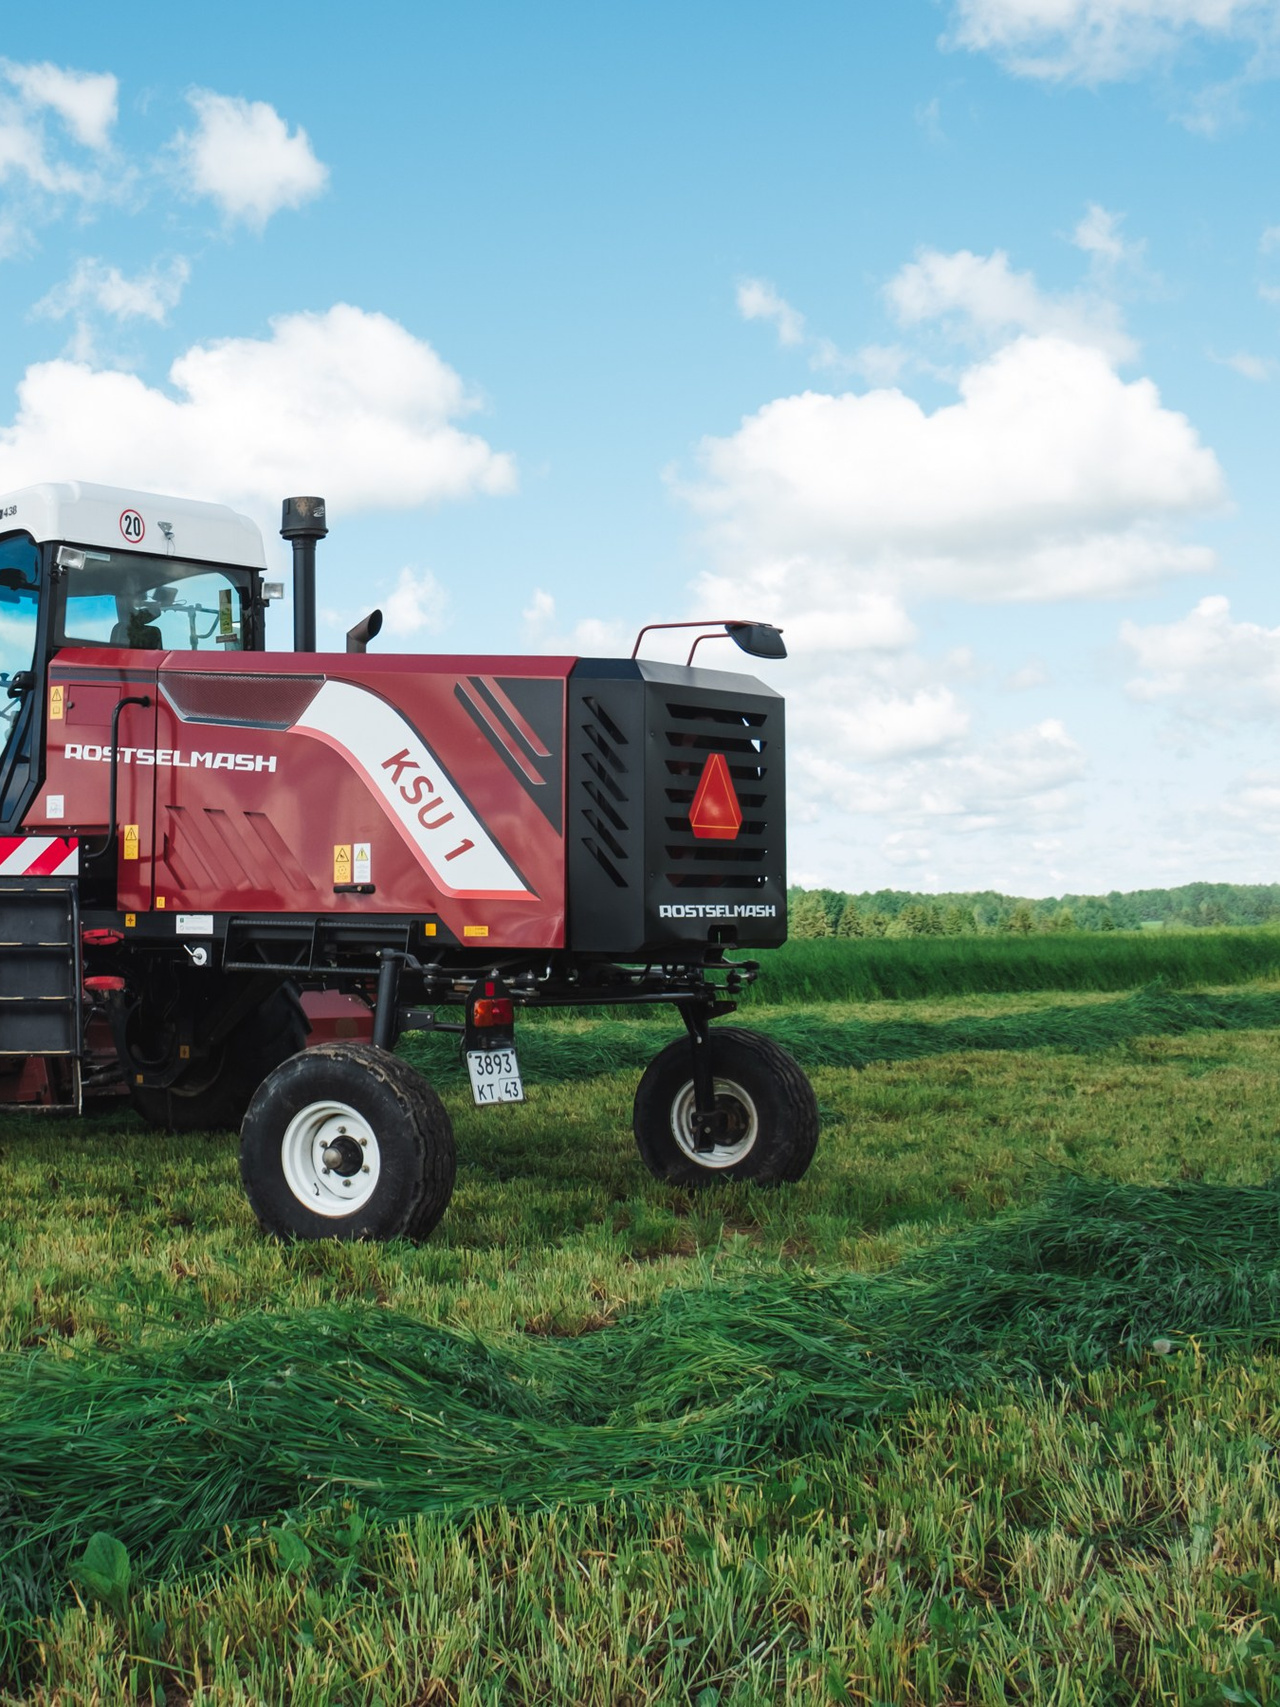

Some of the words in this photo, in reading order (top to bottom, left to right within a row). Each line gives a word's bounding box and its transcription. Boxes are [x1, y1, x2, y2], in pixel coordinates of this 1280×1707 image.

[124, 514, 141, 537] 20
[64, 743, 277, 773] ROSTSELMASH
[381, 748, 455, 830] KSU
[444, 838, 475, 862] 1
[659, 904, 776, 918] ROSTSELMASH
[474, 1053, 512, 1076] 3893
[477, 1083, 494, 1101] KT
[504, 1081, 519, 1098] 43
